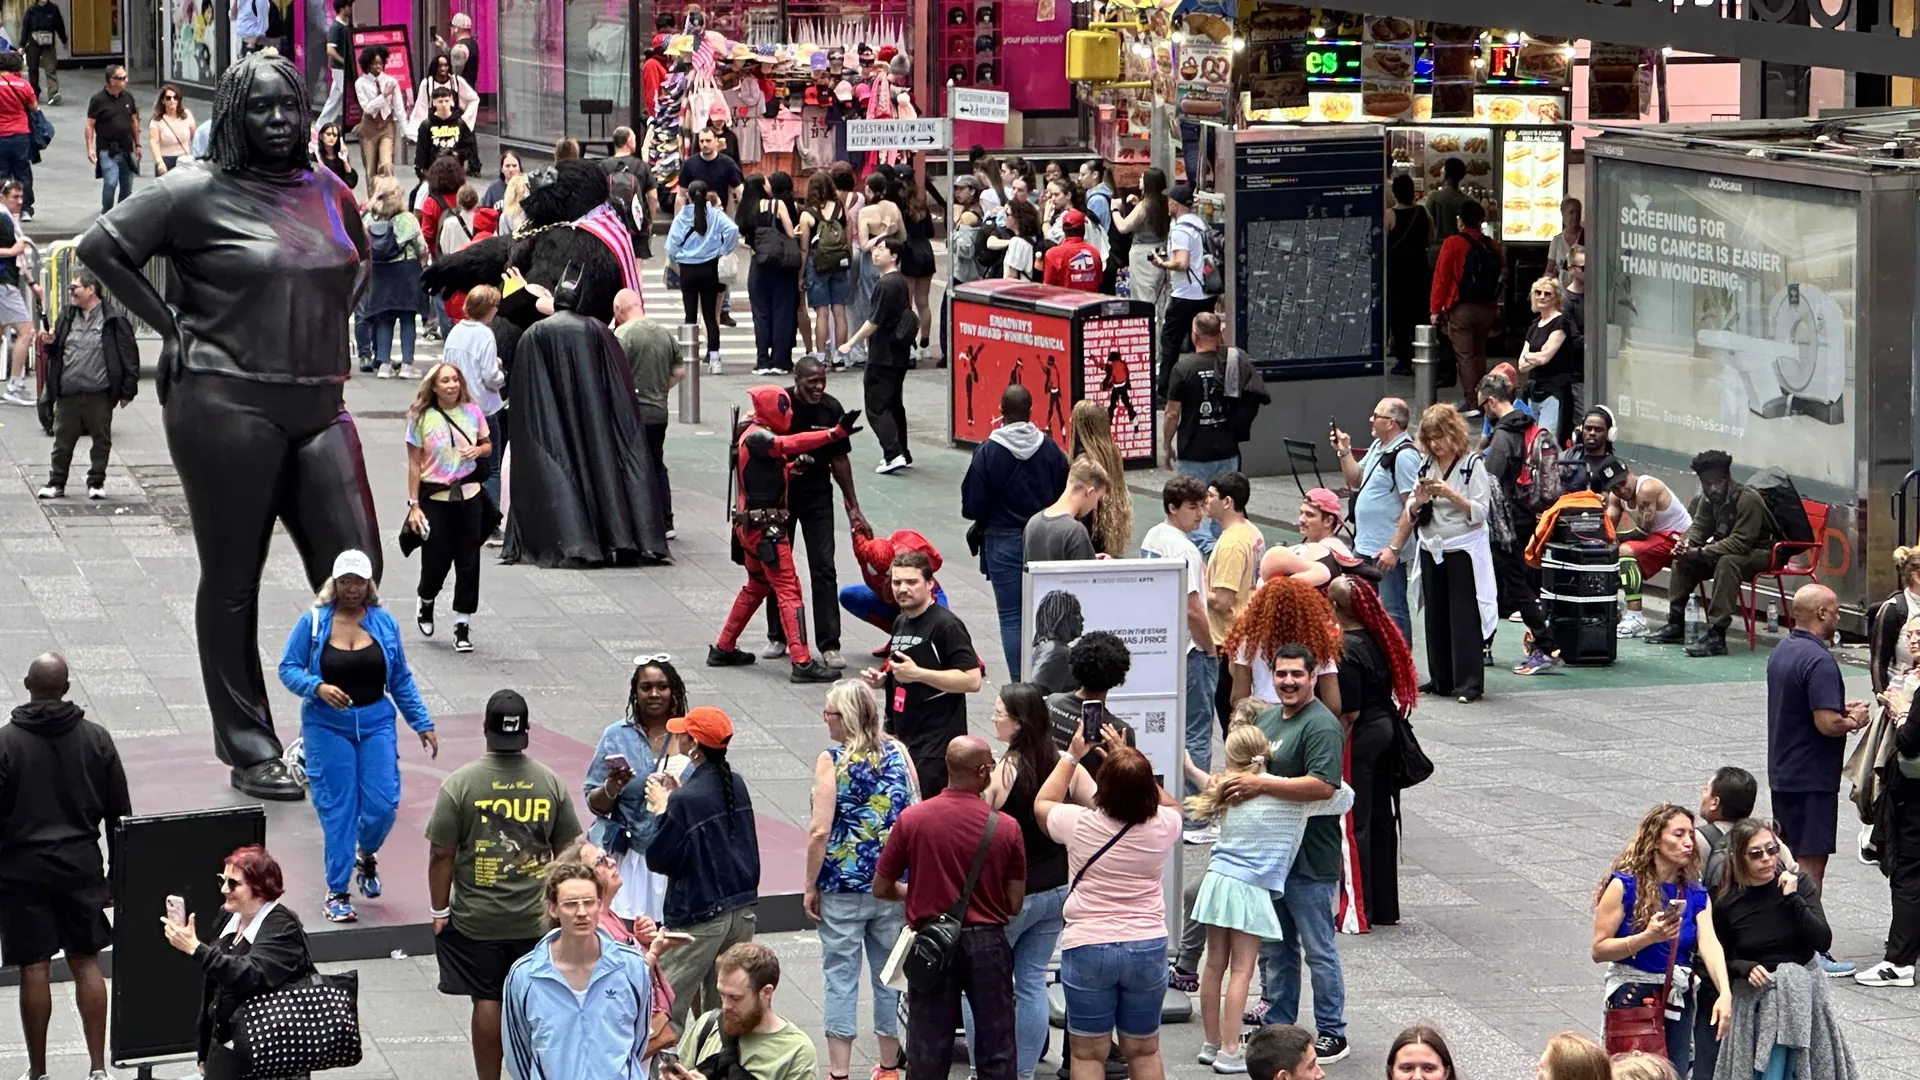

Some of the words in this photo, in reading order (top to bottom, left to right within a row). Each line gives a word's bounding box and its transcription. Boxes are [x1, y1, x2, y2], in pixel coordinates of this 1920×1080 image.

[1004, 37, 1020, 45] your
[1022, 36, 1039, 44] plan
[1040, 35, 1064, 44] price?
[852, 122, 895, 134] PEDESTRIAN
[896, 122, 916, 133] FLOW
[918, 122, 936, 132] ZONE
[852, 136, 870, 146] KEEP
[870, 136, 898, 146] MOVING
[1708, 176, 1743, 192] JCDecaux
[1620, 206, 1698, 235] SCREENING
[1700, 218, 1726, 240] FOR
[1620, 231, 1657, 254] LUNG
[1660, 236, 1714, 263] CANCER
[1716, 245, 1730, 266] IS
[1732, 248, 1782, 274] EASIER
[1620, 255, 1657, 278] THAN
[1660, 261, 1744, 292] WONDERING.
[990, 314, 1032, 333] BROADWAY'S
[1083, 322, 1098, 330] JAM
[1102, 320, 1118, 329] BAD
[1122, 317, 1149, 328] MONEY
[959, 322, 977, 336] TONY
[1034, 335, 1066, 352] MUSICAL
[1084, 329, 1114, 340] SMOOTH
[1663, 410, 1745, 439] SavedByTheScan.org
[1144, 636, 1167, 644] PRICE
[474, 798, 551, 823] TOUR
